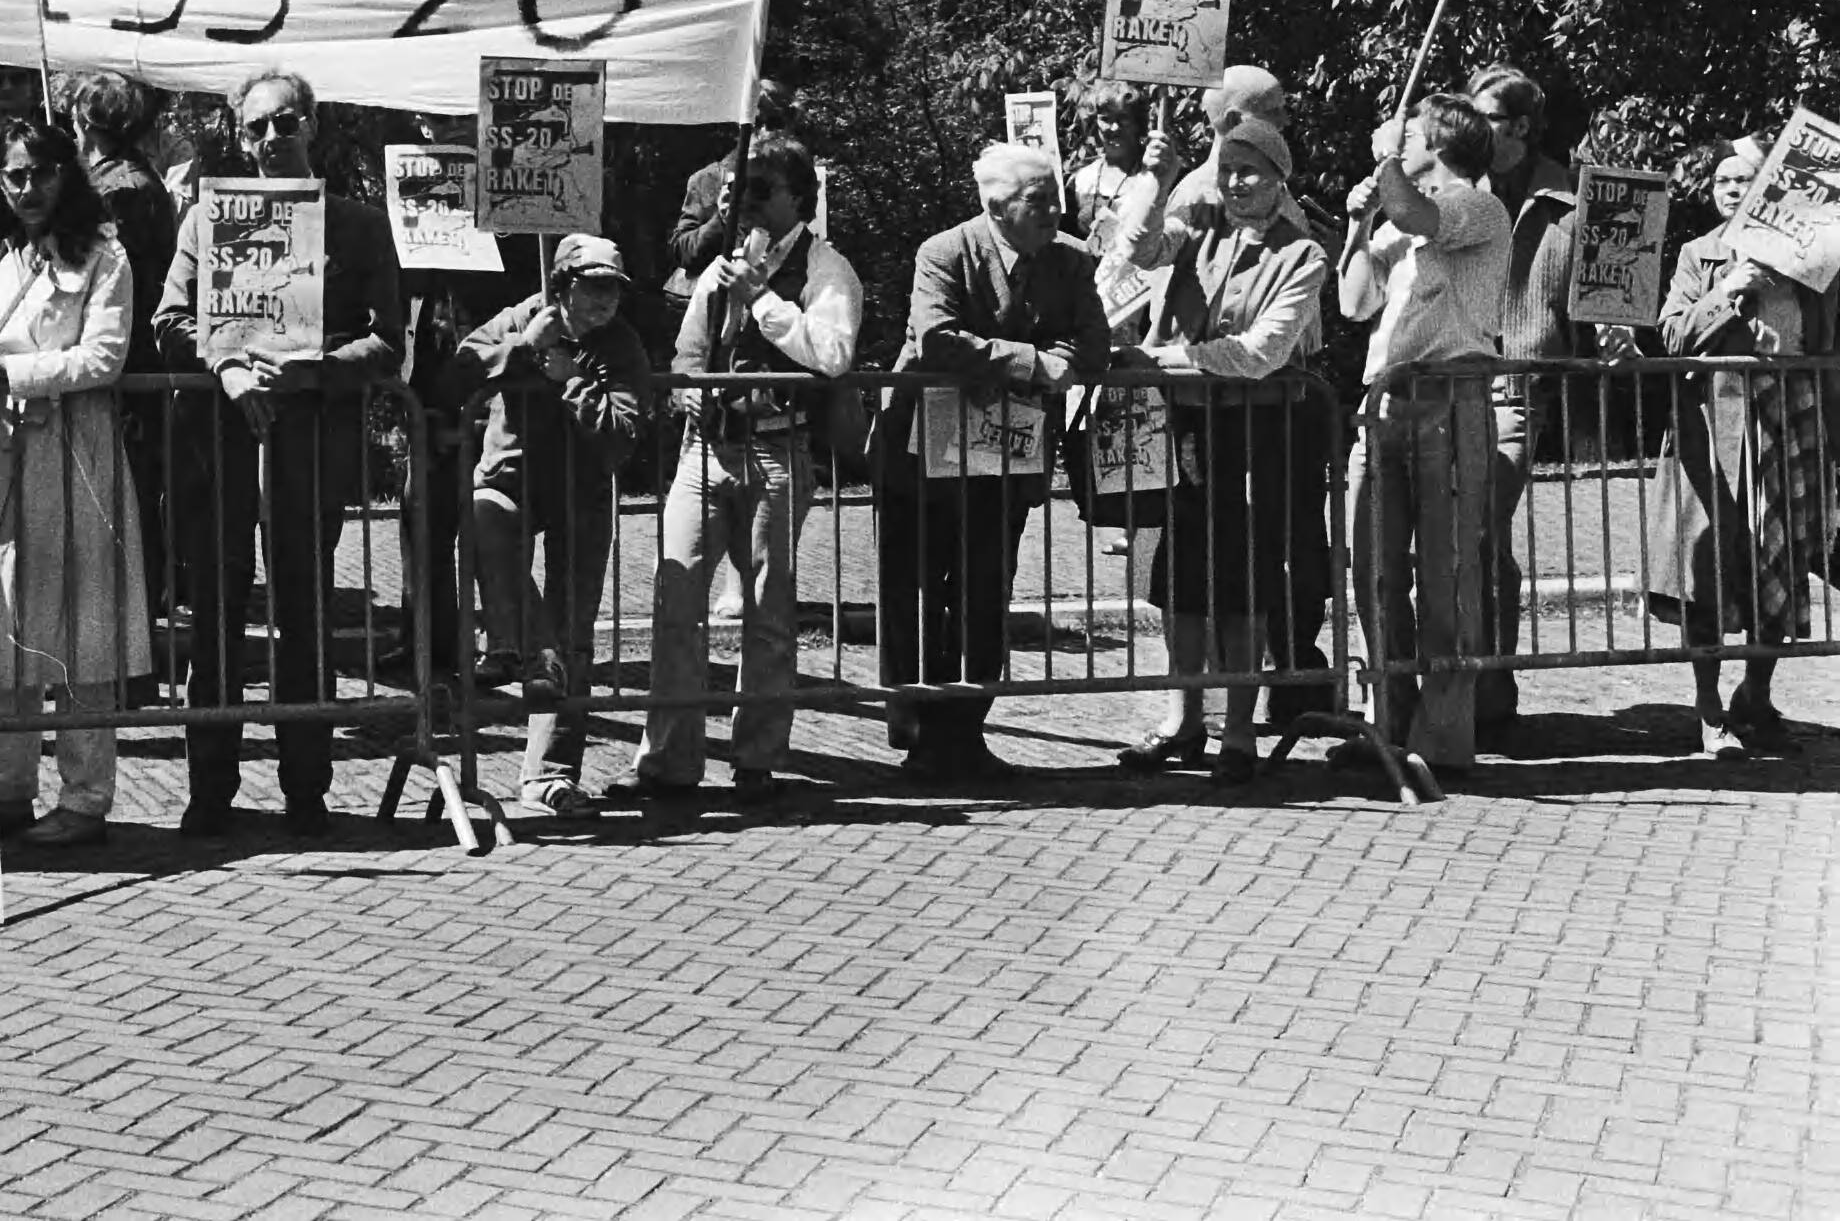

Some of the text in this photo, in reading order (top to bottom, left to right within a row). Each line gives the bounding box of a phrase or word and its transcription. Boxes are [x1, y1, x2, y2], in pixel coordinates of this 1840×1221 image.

[489, 76, 572, 101] STOP DE
[486, 126, 552, 150] SS-20
[394, 156, 465, 178] STOP DE
[1586, 181, 1649, 206] STOP DE
[208, 194, 293, 221] STOP DE
[1581, 225, 1628, 247] SS-20
[207, 246, 273, 272] SS-20
